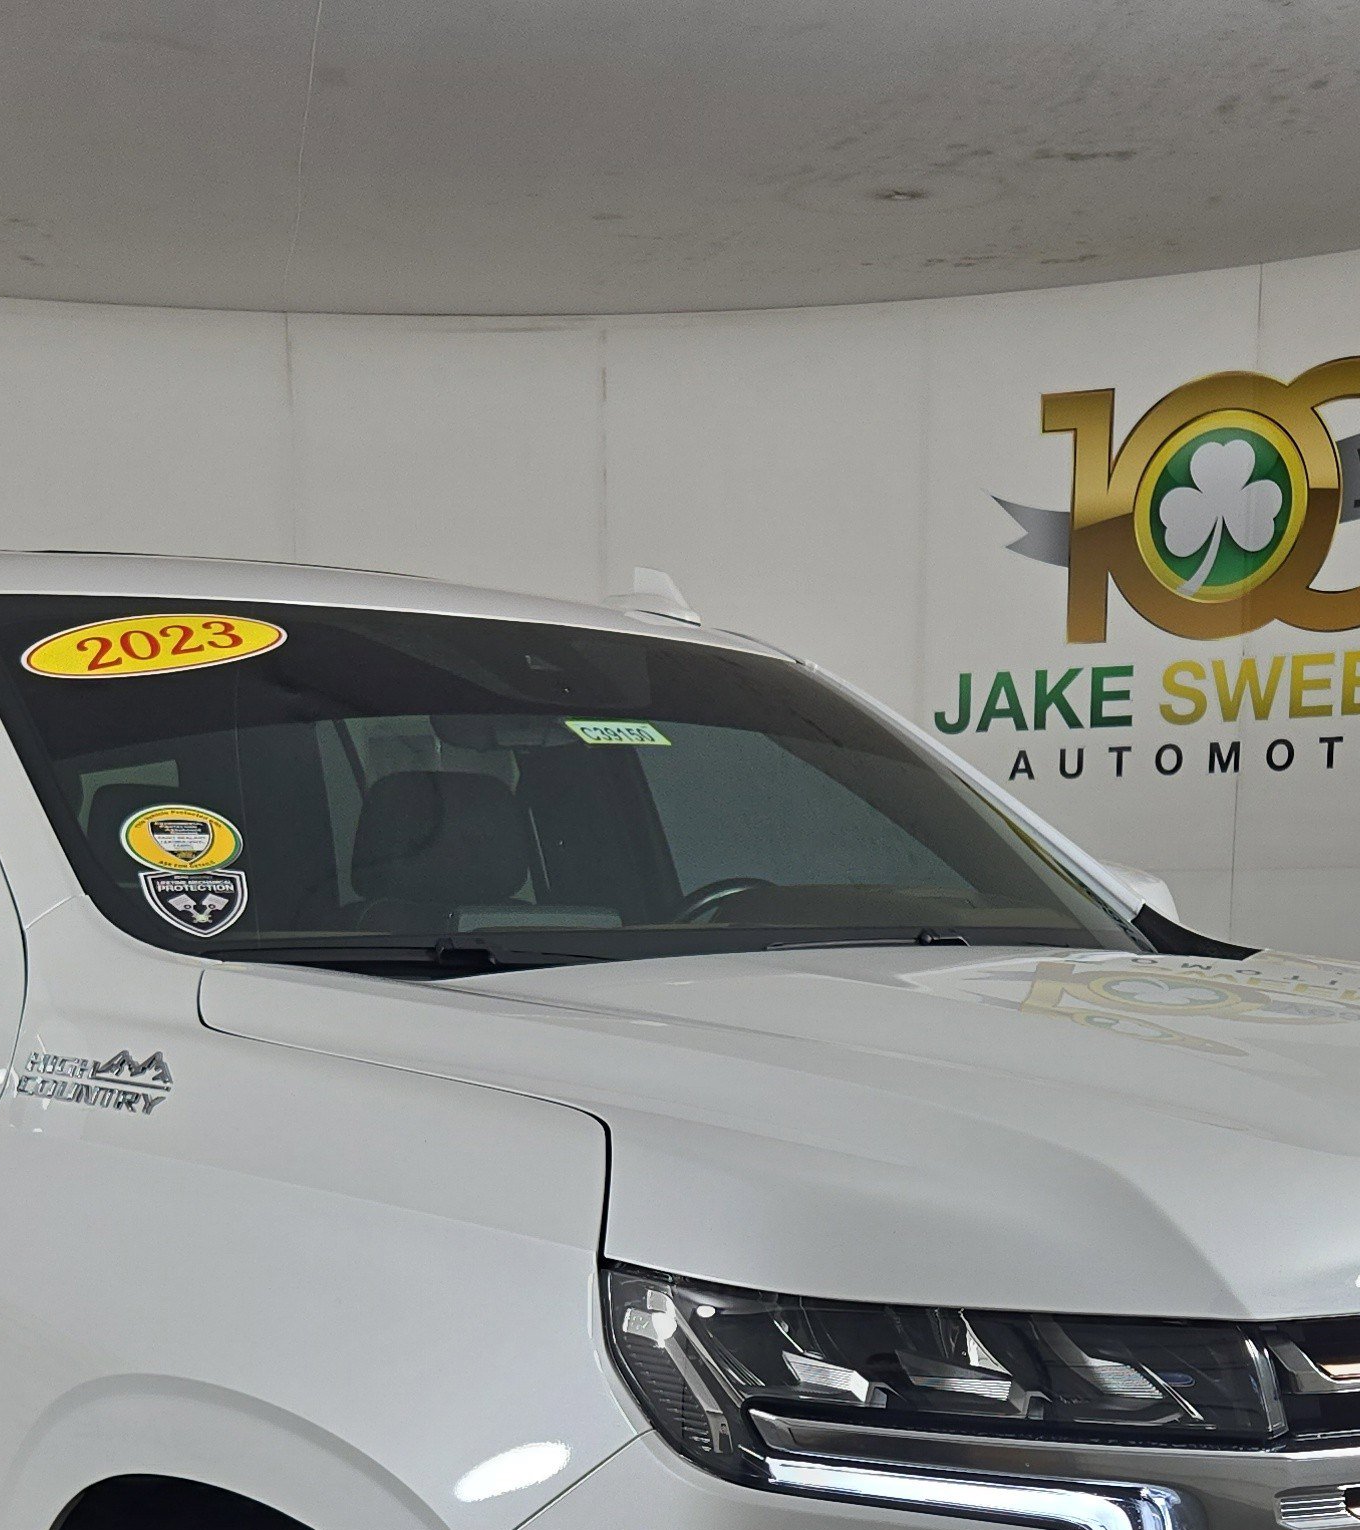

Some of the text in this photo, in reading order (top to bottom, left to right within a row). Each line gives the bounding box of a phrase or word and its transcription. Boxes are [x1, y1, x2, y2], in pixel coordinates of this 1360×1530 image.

[76, 621, 244, 671] 2023
[934, 664, 1134, 736] JAKE
[158, 884, 235, 892] PROTECTION
[26, 1052, 101, 1079] HIGH
[17, 1075, 167, 1115] COUNTRY
